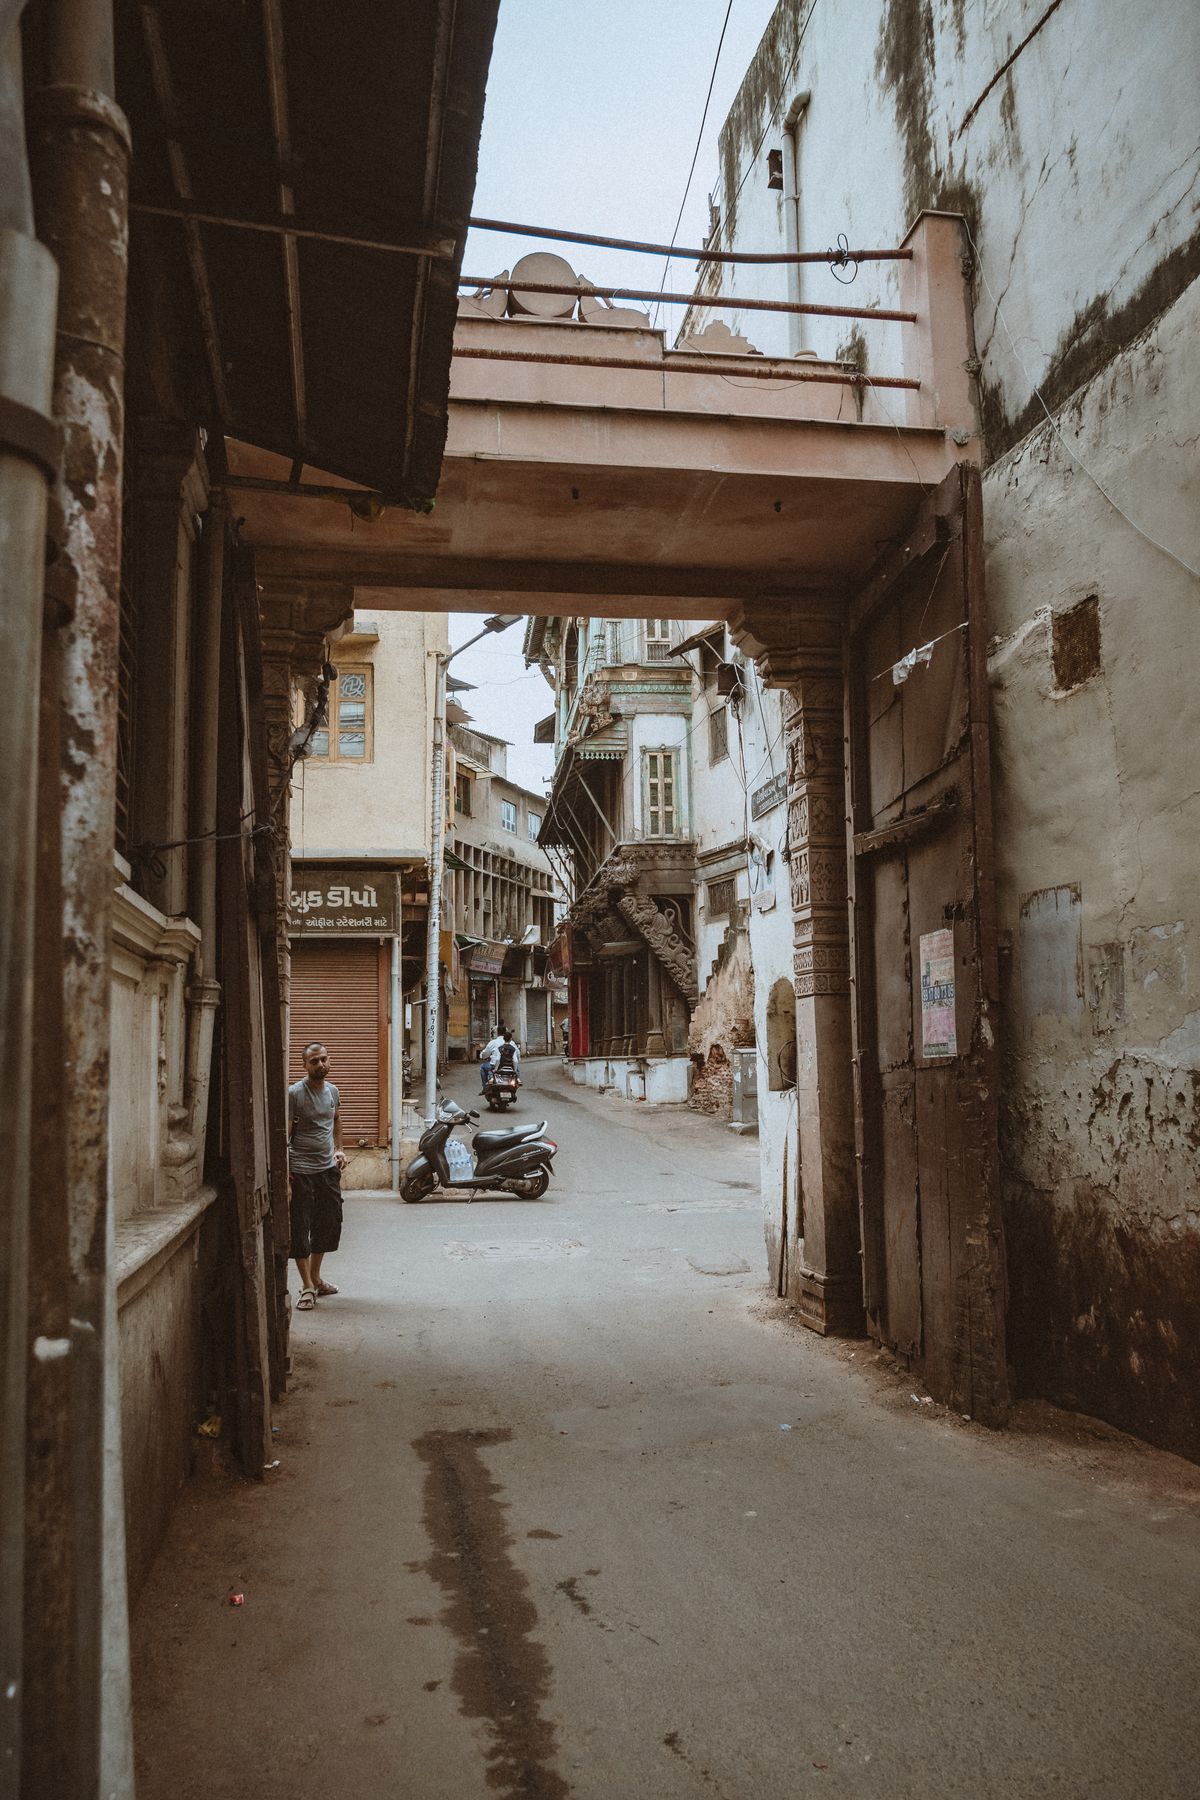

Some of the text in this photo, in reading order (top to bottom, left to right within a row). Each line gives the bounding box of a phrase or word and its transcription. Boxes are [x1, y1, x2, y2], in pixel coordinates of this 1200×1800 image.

[290, 885, 378, 914] બુક ડીપો
[373, 916, 388, 927] માટે
